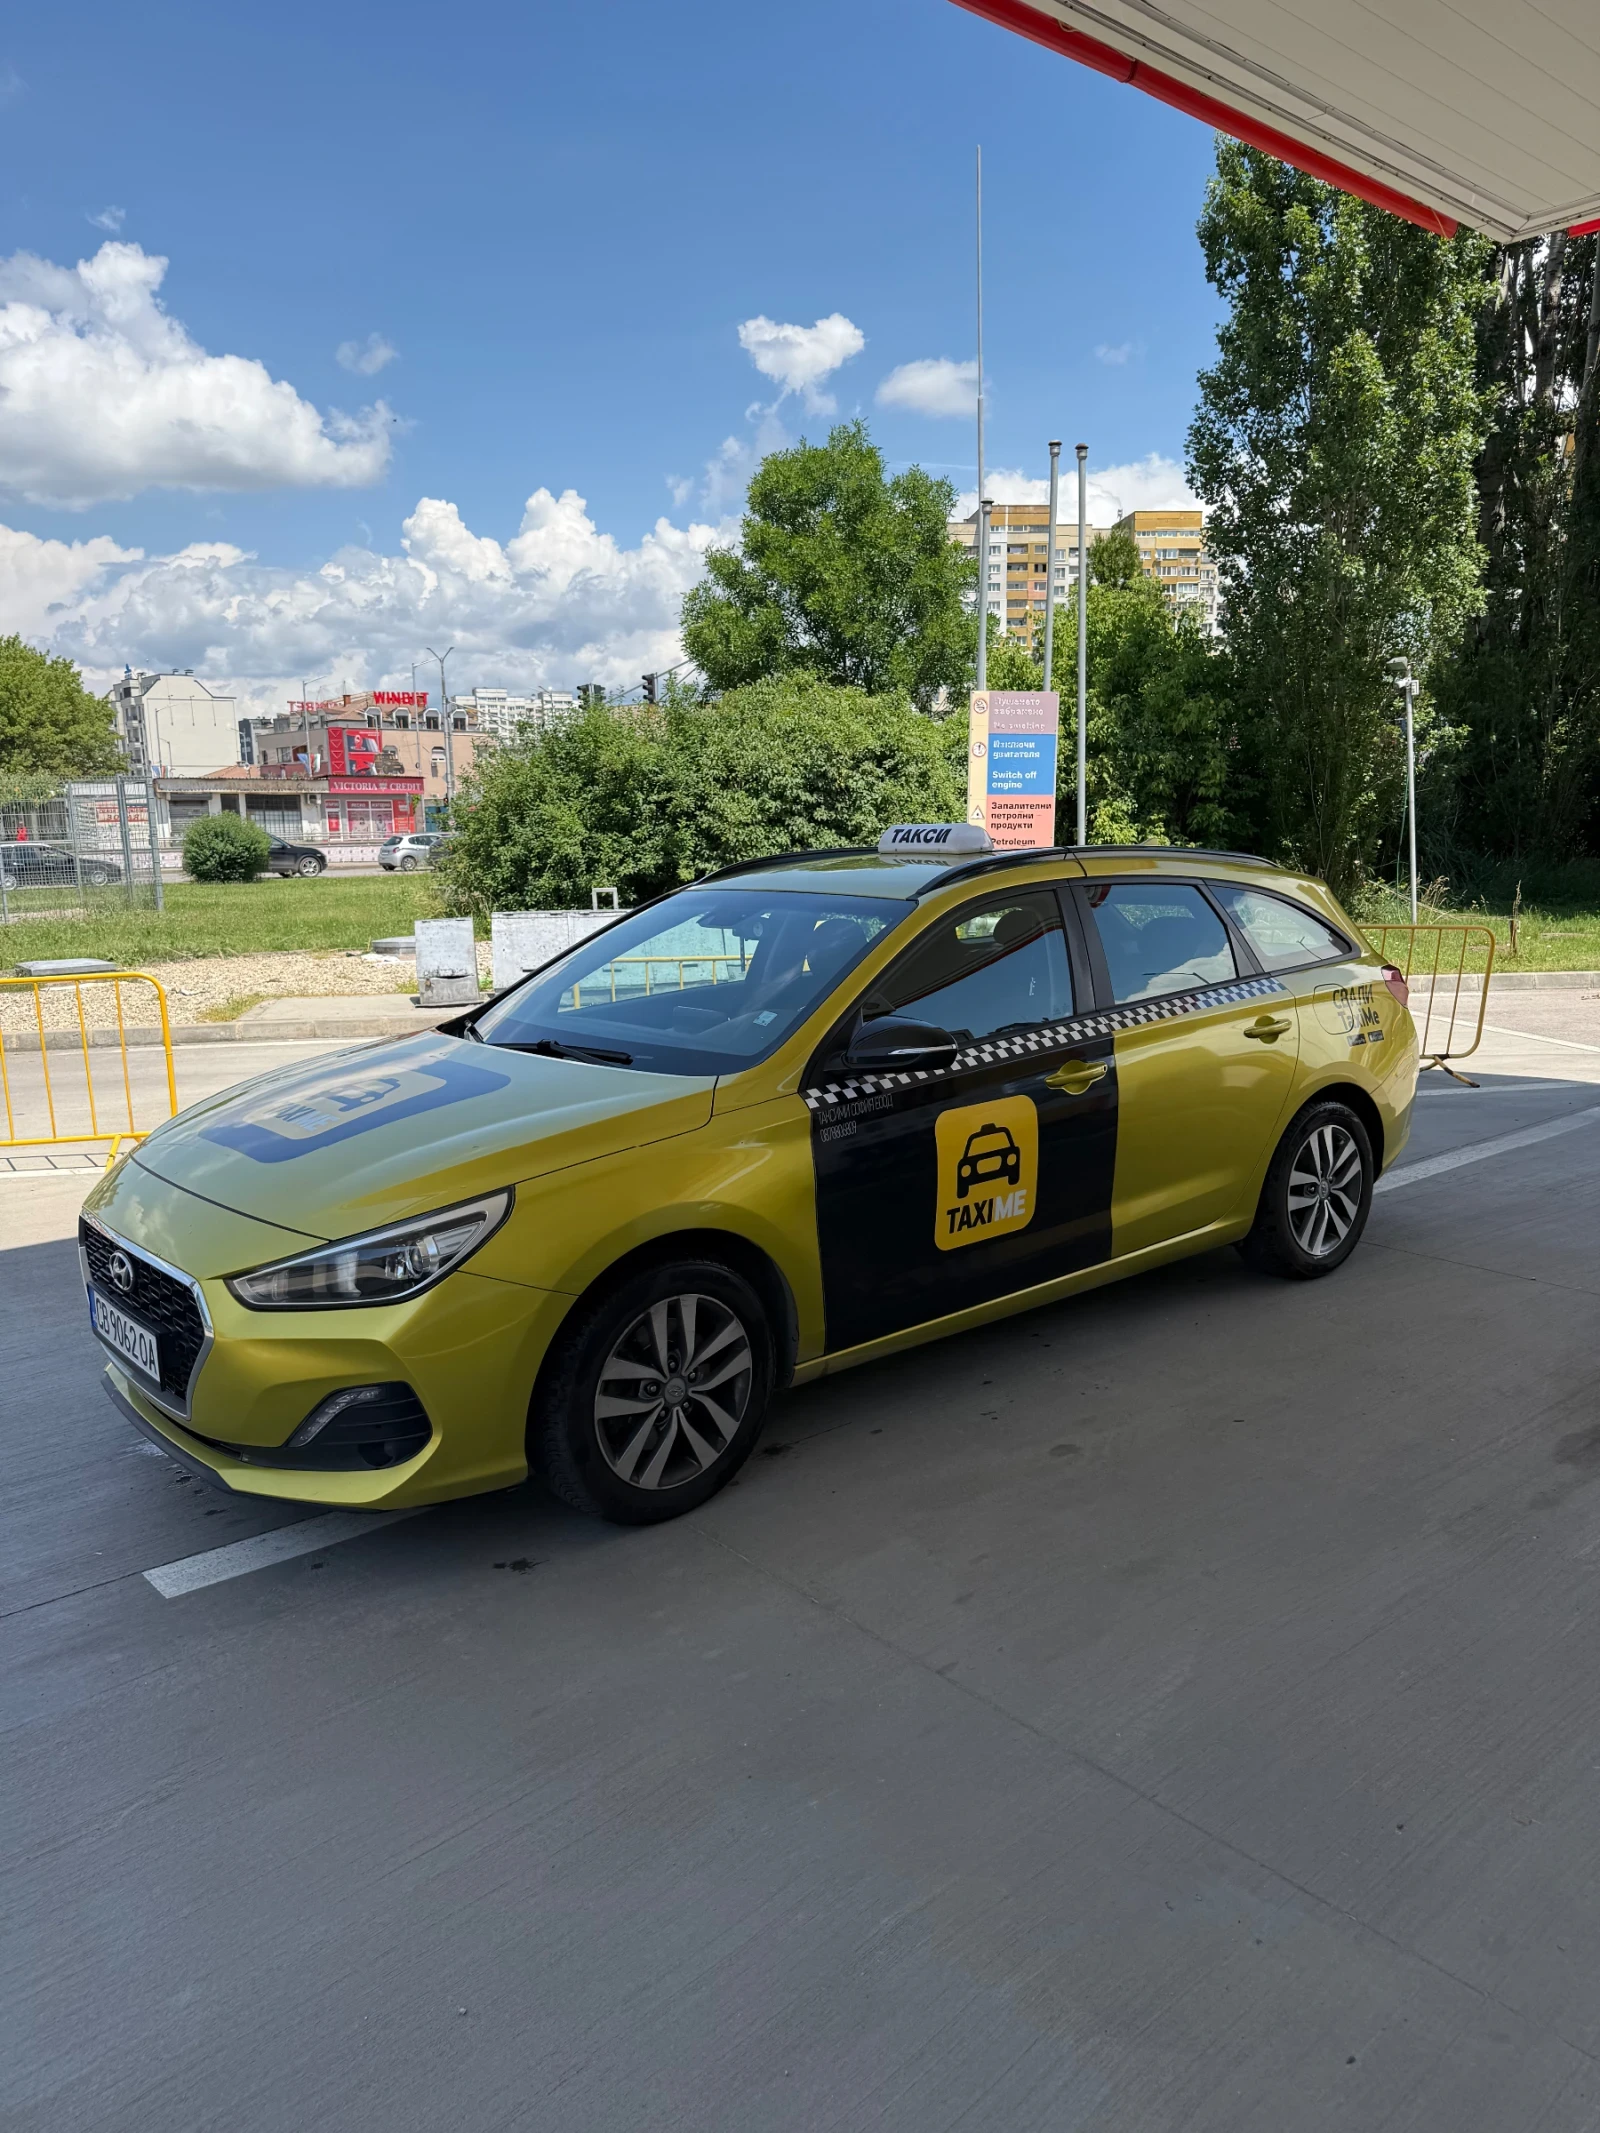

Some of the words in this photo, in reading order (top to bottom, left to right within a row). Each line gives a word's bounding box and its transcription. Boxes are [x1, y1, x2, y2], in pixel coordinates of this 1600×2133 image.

[373, 691, 429, 707] WINBET
[993, 740, 1036, 749] Изключи
[993, 751, 1040, 760] двигателя
[992, 771, 1023, 779] Switch
[1025, 771, 1037, 779] off
[333, 781, 378, 791] VICTORIA
[389, 782, 422, 791] CREDIT
[992, 781, 1023, 790] engine
[991, 801, 1052, 810] Запалителни
[991, 812, 1034, 820] петролни
[990, 822, 1033, 830] продукти
[891, 828, 952, 844] ТАКСИ
[991, 838, 1036, 846] Petroleum
[1337, 1007, 1381, 1031] TaxiMe
[946, 1188, 1028, 1235] TAXIME
